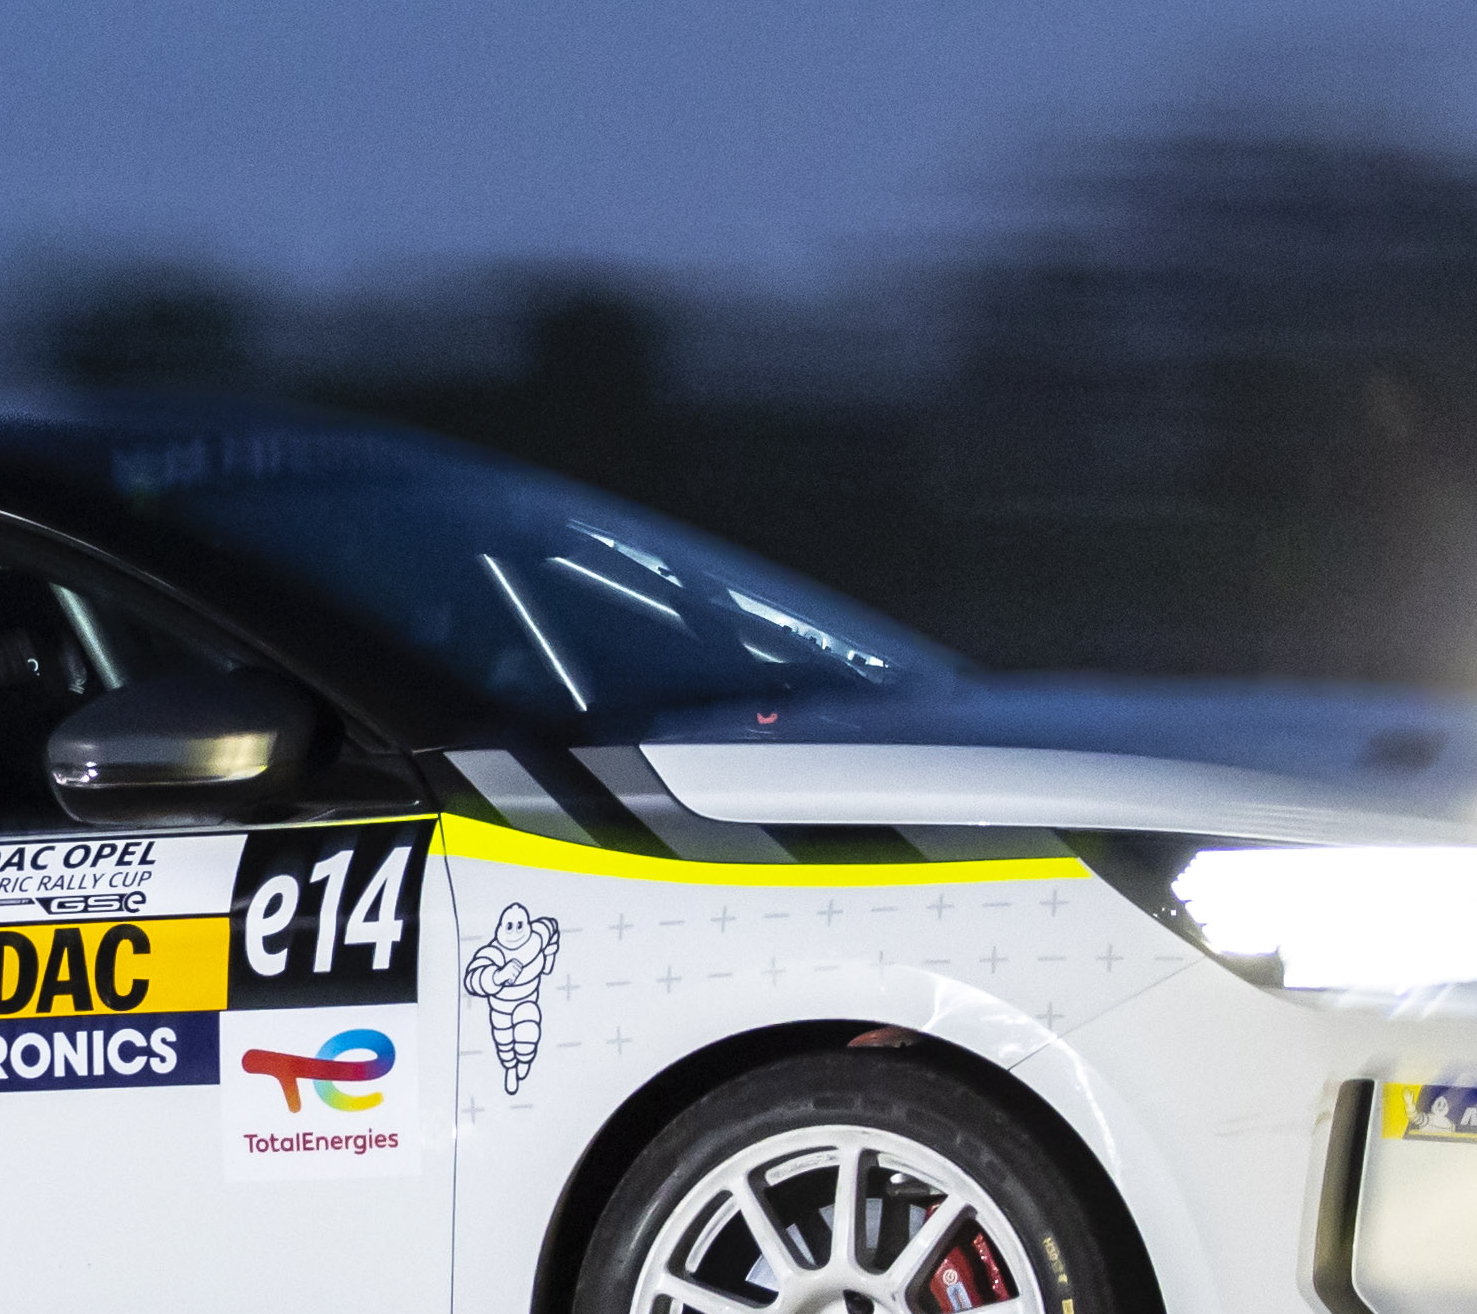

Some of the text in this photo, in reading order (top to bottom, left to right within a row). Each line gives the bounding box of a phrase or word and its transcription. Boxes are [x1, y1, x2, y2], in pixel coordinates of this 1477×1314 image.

[63, 841, 157, 869] OPEL
[37, 873, 105, 891] RALLY
[108, 870, 153, 888] CUP
[245, 846, 412, 977] e14
[243, 1128, 399, 1155] TotalEnergies
